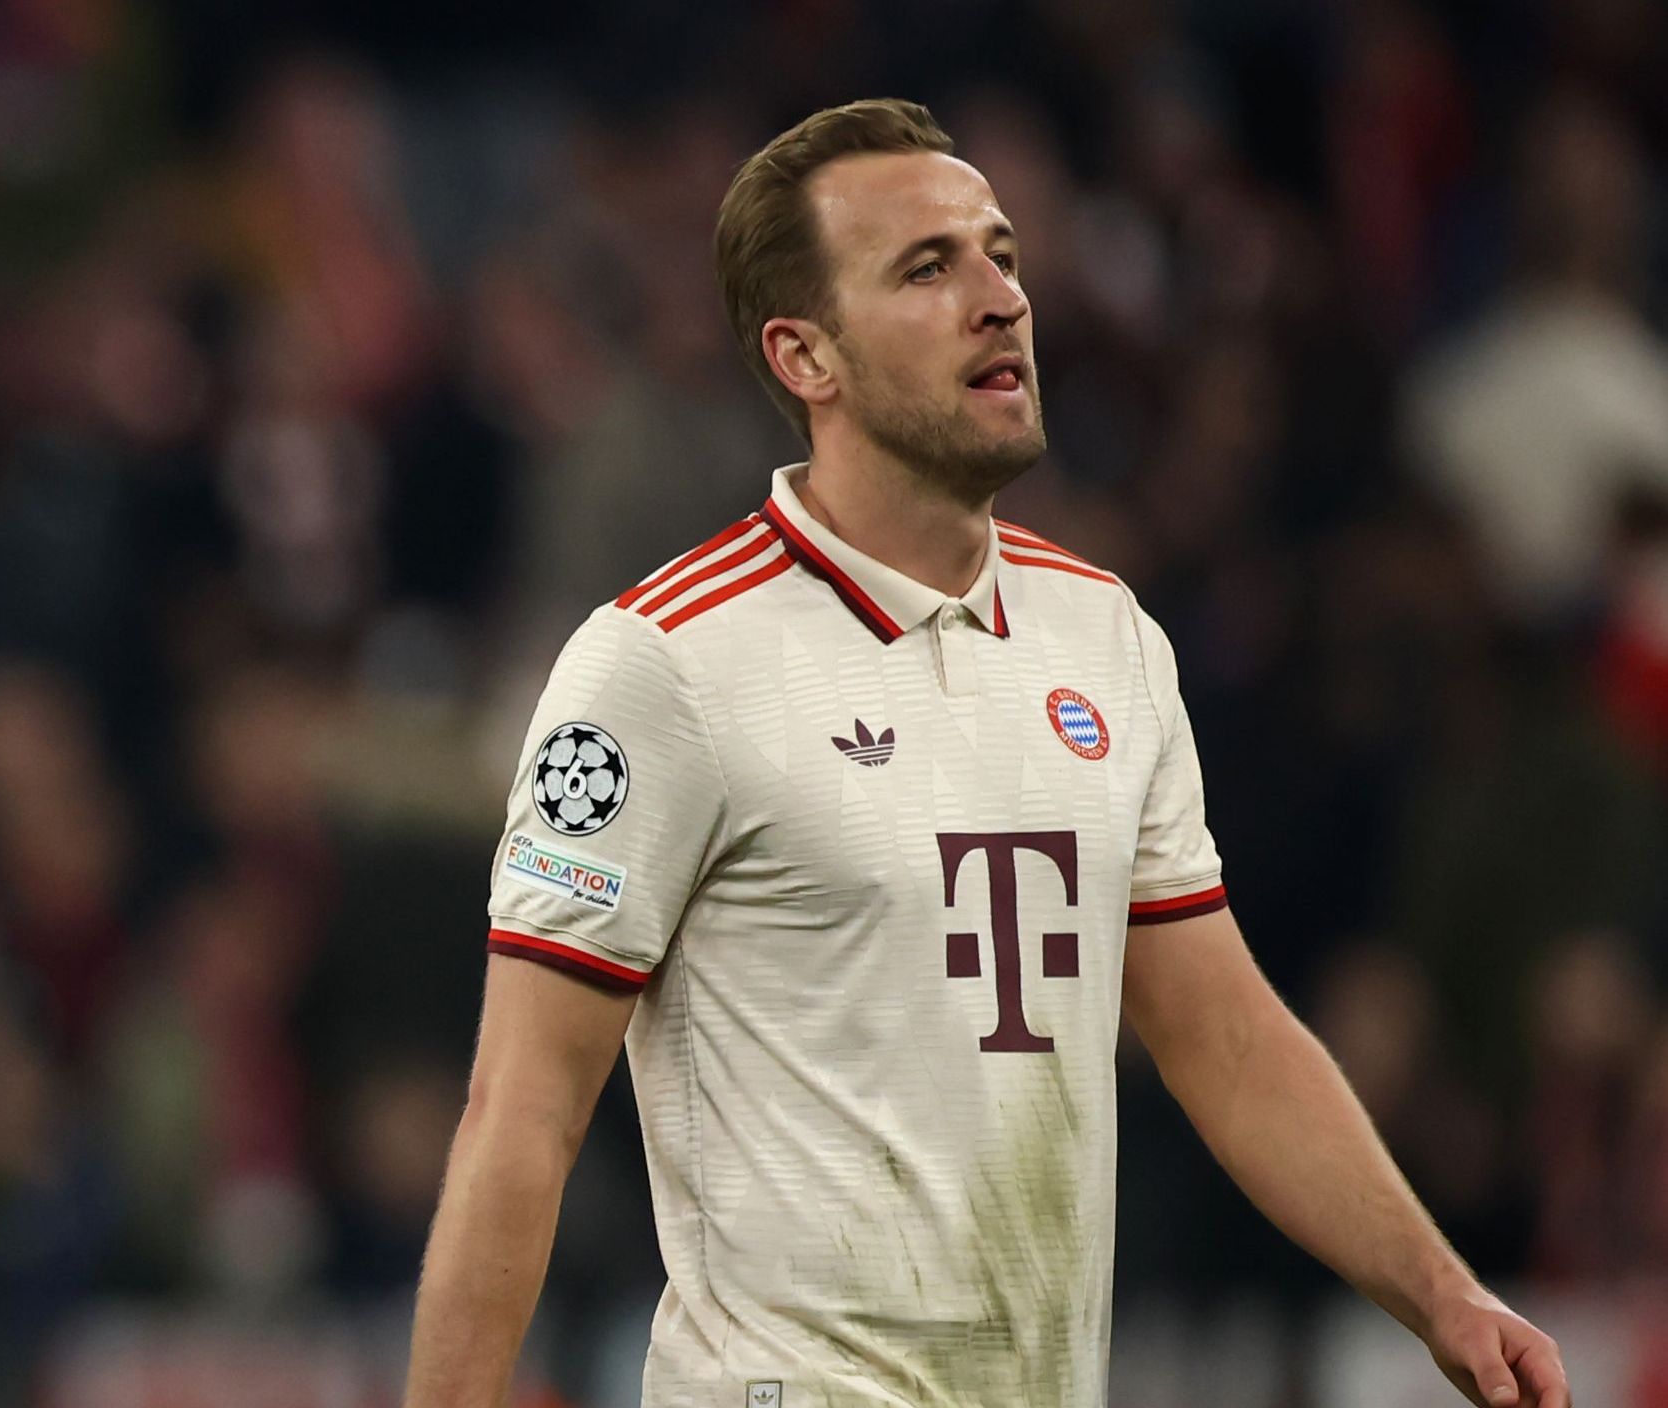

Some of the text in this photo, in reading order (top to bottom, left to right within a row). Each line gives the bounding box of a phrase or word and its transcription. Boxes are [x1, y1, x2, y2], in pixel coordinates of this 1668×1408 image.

[563, 758, 587, 799] 6
[511, 834, 533, 849] UEFA
[572, 888, 614, 908] for children
[936, 831, 1079, 1053] T
